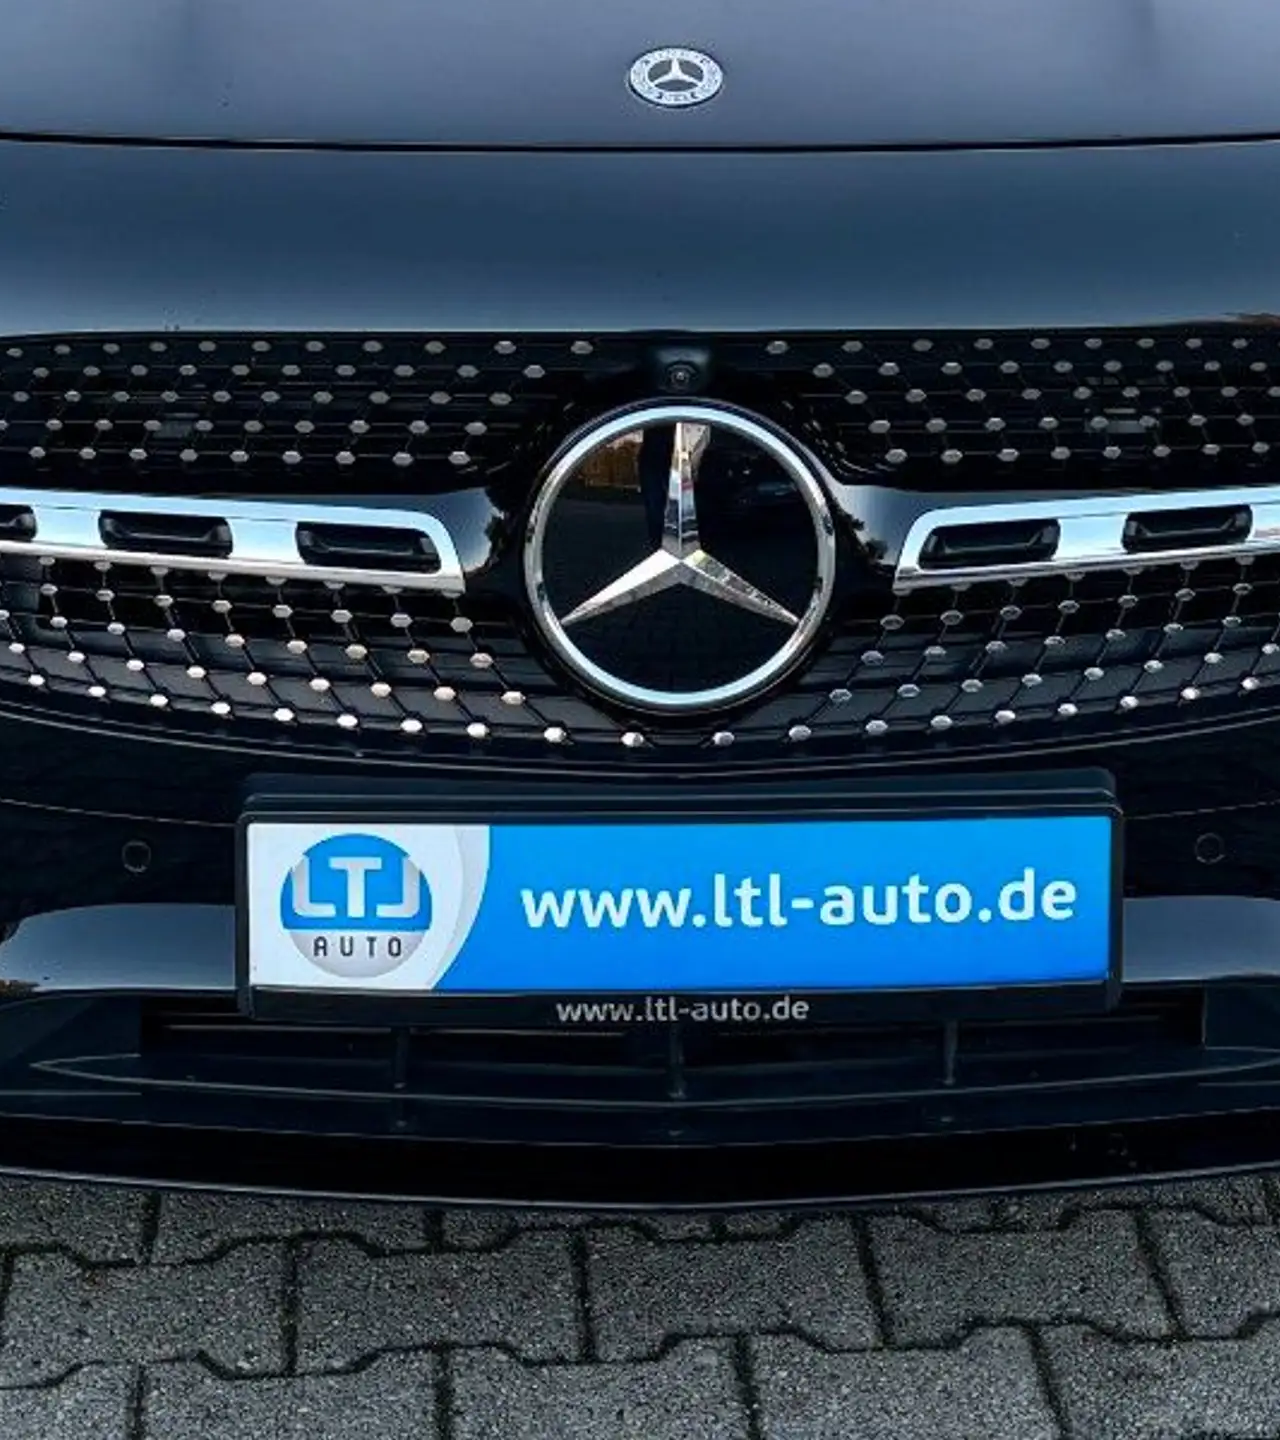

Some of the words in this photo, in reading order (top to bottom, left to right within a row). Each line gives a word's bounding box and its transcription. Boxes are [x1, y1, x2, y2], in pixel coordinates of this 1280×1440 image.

[520, 867, 1077, 929] www.ltl-auto.de
[313, 935, 402, 958] AUTO
[556, 995, 810, 1023] www.ltl-auto.de
